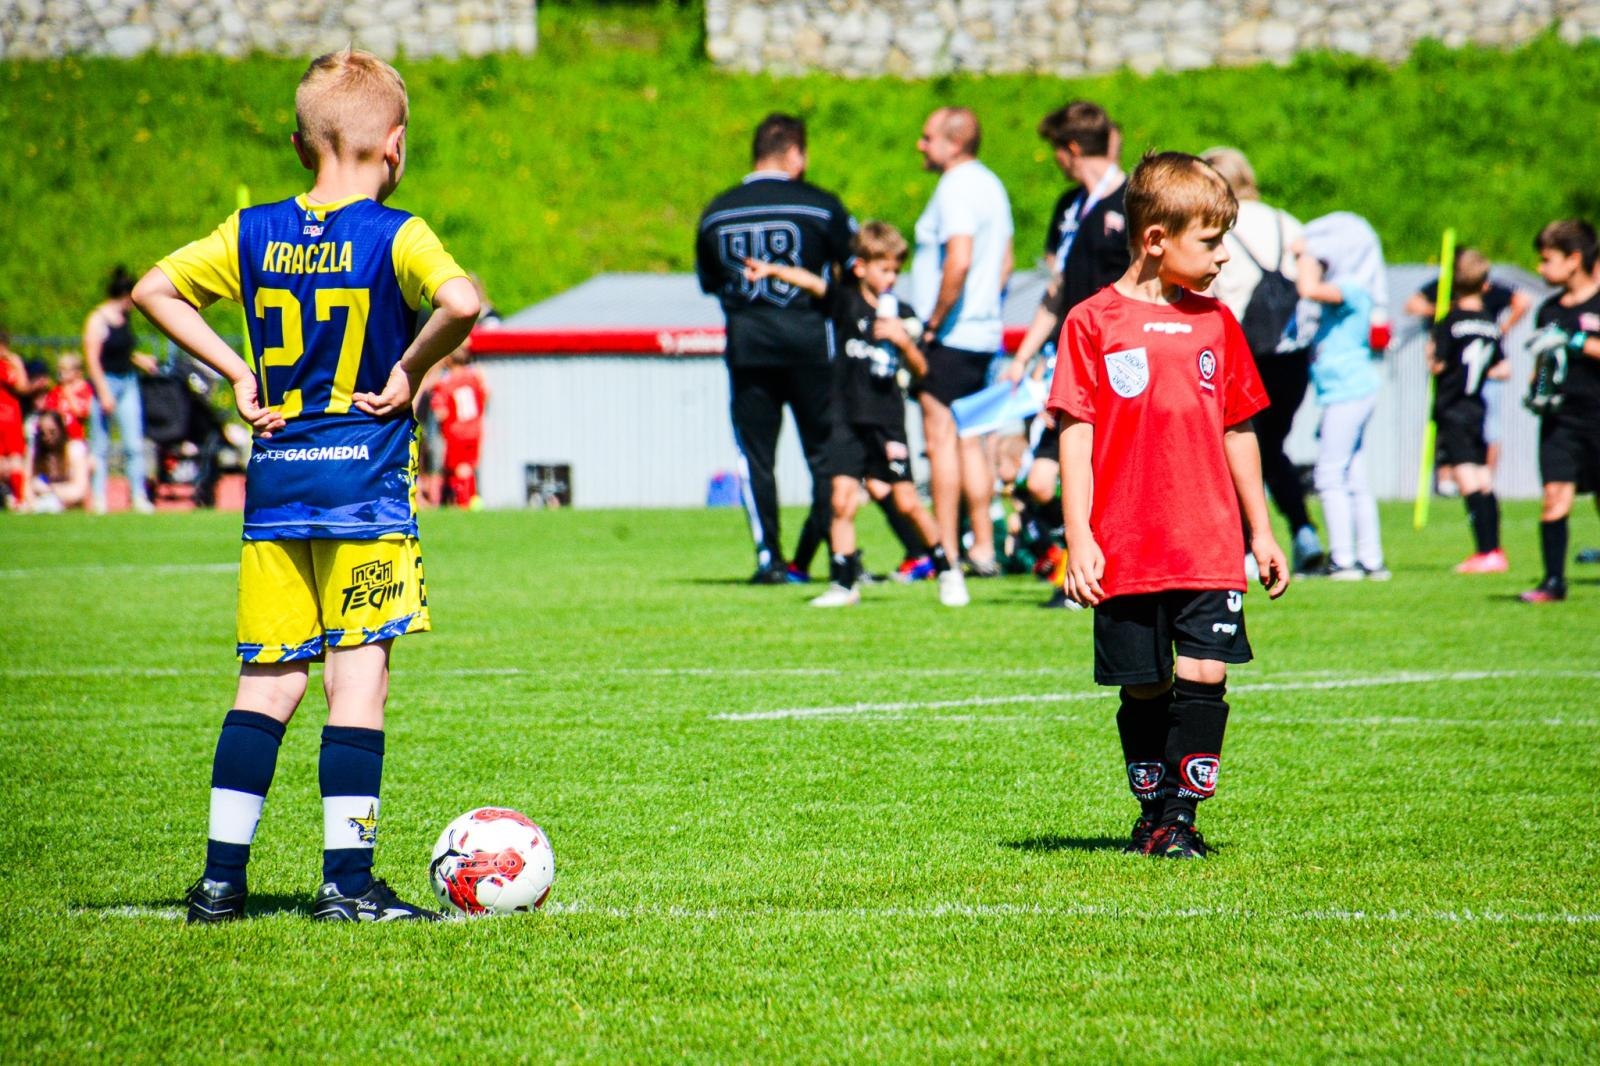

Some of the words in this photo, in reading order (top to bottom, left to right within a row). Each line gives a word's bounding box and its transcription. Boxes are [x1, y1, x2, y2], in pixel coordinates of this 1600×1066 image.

[262, 241, 352, 274] KRACZLA
[254, 287, 371, 419] 27
[284, 444, 370, 462] GAGMEDIA
